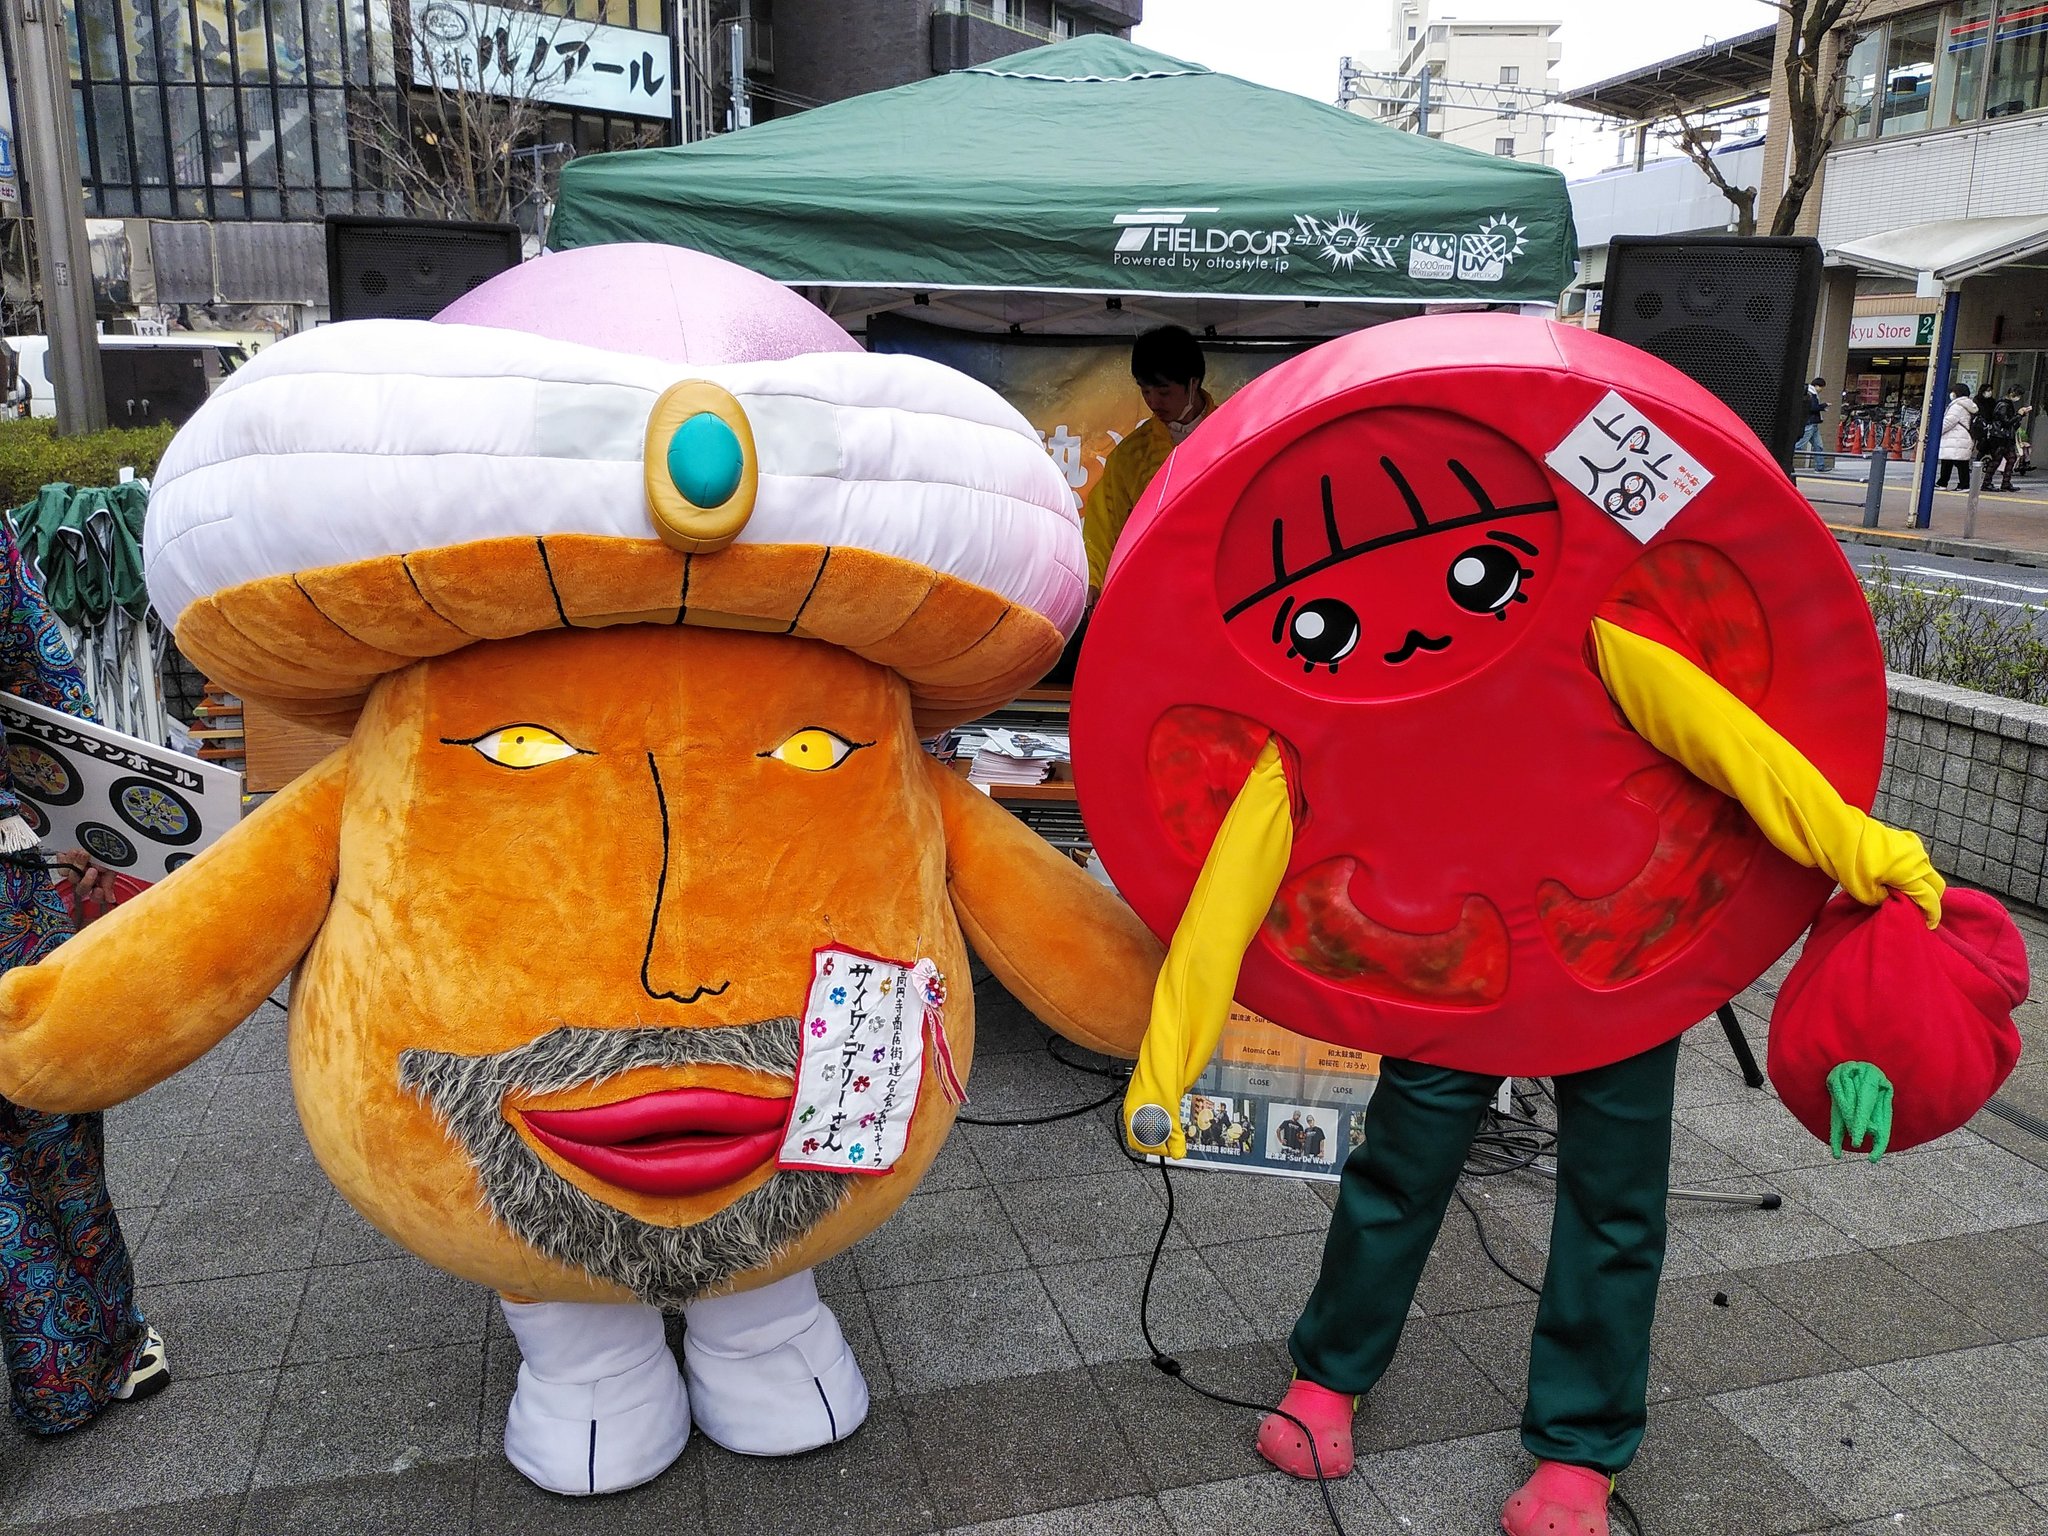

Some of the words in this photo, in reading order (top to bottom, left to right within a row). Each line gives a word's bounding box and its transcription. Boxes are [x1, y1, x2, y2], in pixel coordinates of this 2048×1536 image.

[480, 27, 665, 97] ルノアール
[1113, 253, 1176, 267] Powered
[1183, 254, 1200, 271] by
[1206, 256, 1290, 273] ottostyle.jp
[1413, 261, 1452, 270] 2,000mm
[1462, 255, 1490, 271] UV
[1877, 323, 1911, 338] Store
[1920, 316, 1935, 334] 2
[1592, 413, 1673, 480] トマト
[1242, 1046, 1265, 1055] Atomic
[1267, 1048, 1280, 1056] Cats
[1249, 1077, 1270, 1086] CLOSE
[1332, 1086, 1353, 1095] CLOSE
